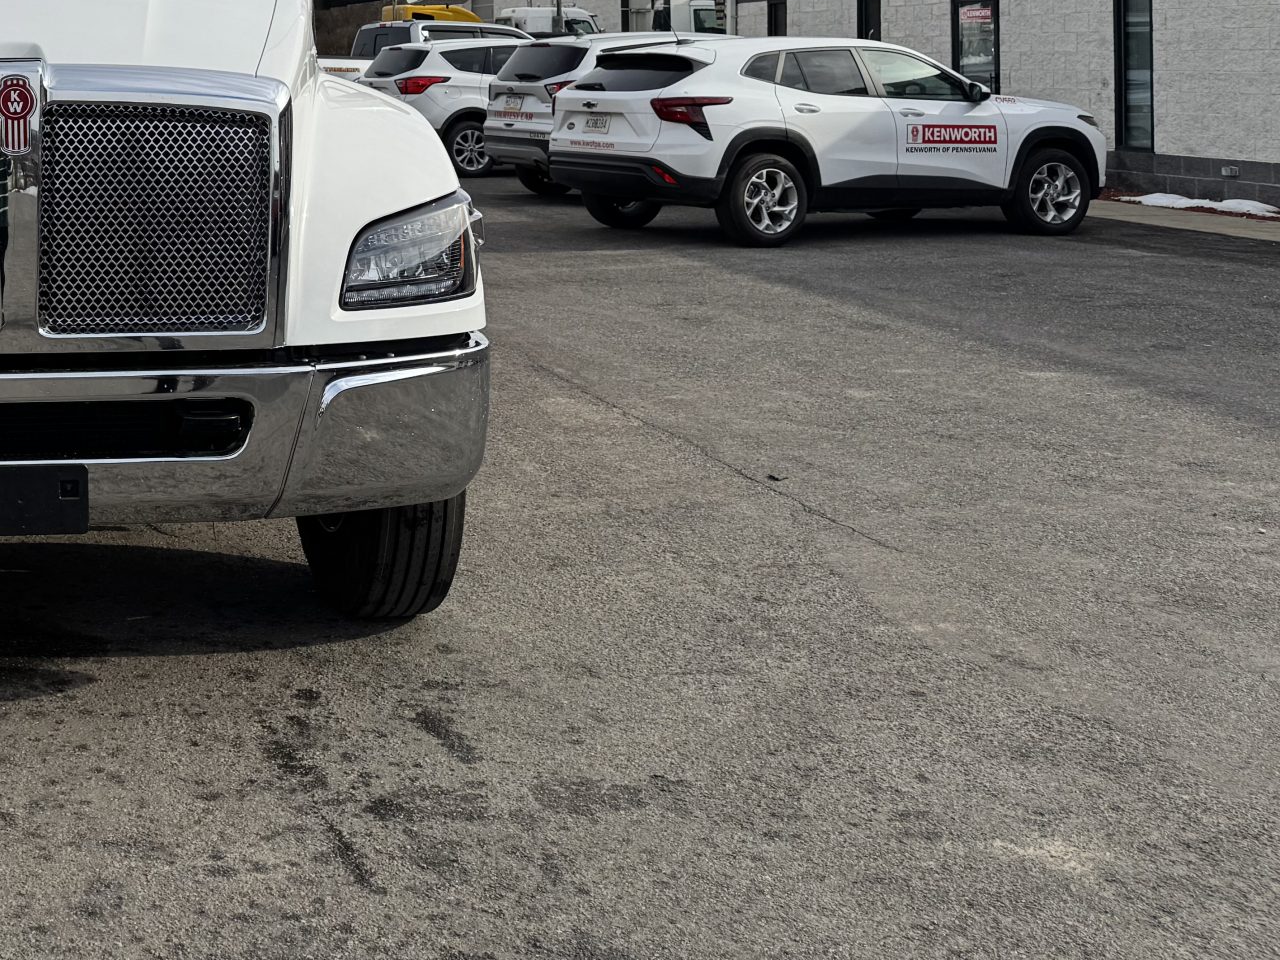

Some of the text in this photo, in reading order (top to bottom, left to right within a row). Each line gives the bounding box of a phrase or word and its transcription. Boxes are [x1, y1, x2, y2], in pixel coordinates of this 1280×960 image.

[10, 90, 21, 102] K
[7, 101, 24, 113] W
[520, 112, 534, 121] CAR
[924, 127, 995, 142] KENWORTH
[569, 140, 615, 150] www.kwofpa.com
